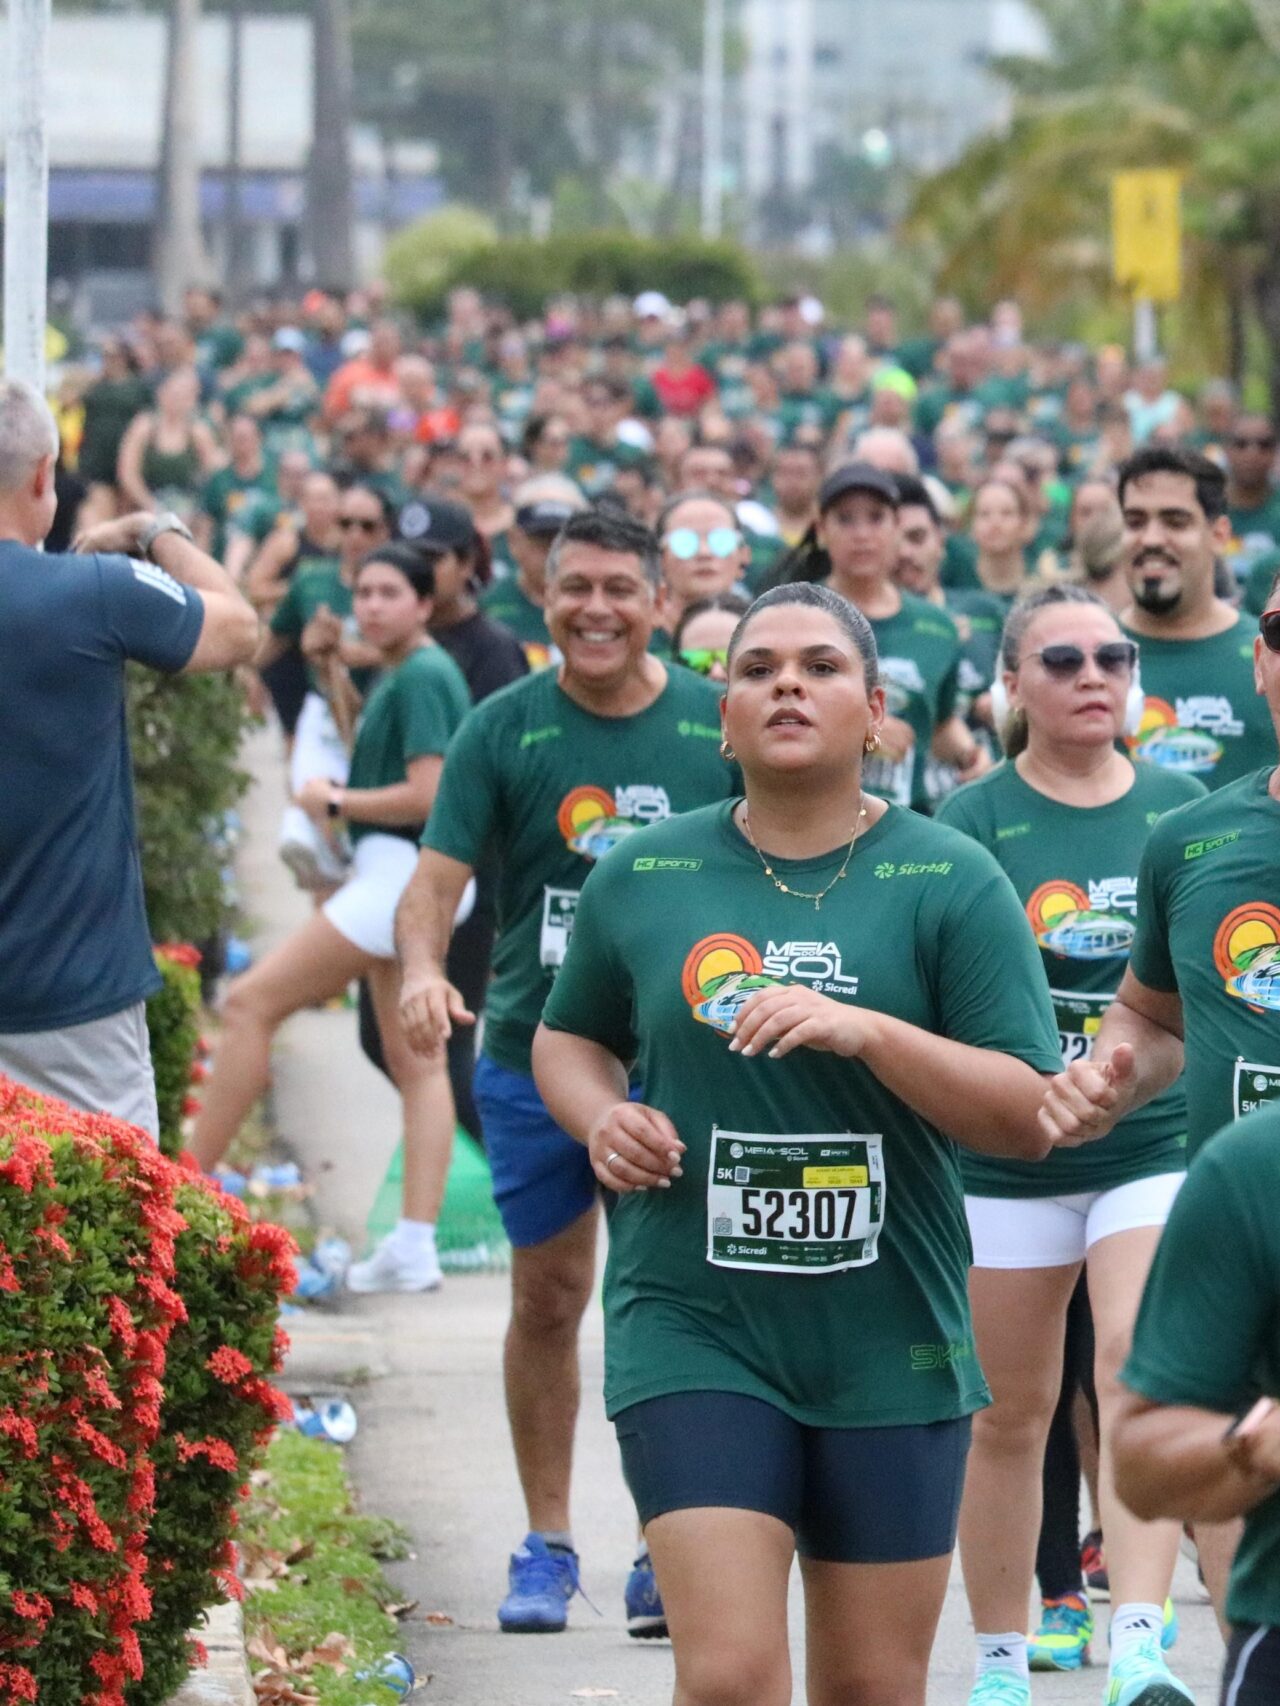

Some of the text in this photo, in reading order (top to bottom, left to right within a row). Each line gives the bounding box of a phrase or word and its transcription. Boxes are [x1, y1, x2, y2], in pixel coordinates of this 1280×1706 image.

[657, 860, 698, 869] SPORTS
[897, 862, 953, 876] Sicredi
[764, 941, 841, 957] MEIA
[762, 956, 858, 984] SOL
[824, 983, 857, 995] Sicredi
[1242, 1100, 1258, 1112] 5K
[780, 1147, 809, 1155] SOL
[717, 1168, 733, 1180] 5K
[742, 1189, 857, 1239] 52307
[738, 1245, 768, 1256] Sicredi
